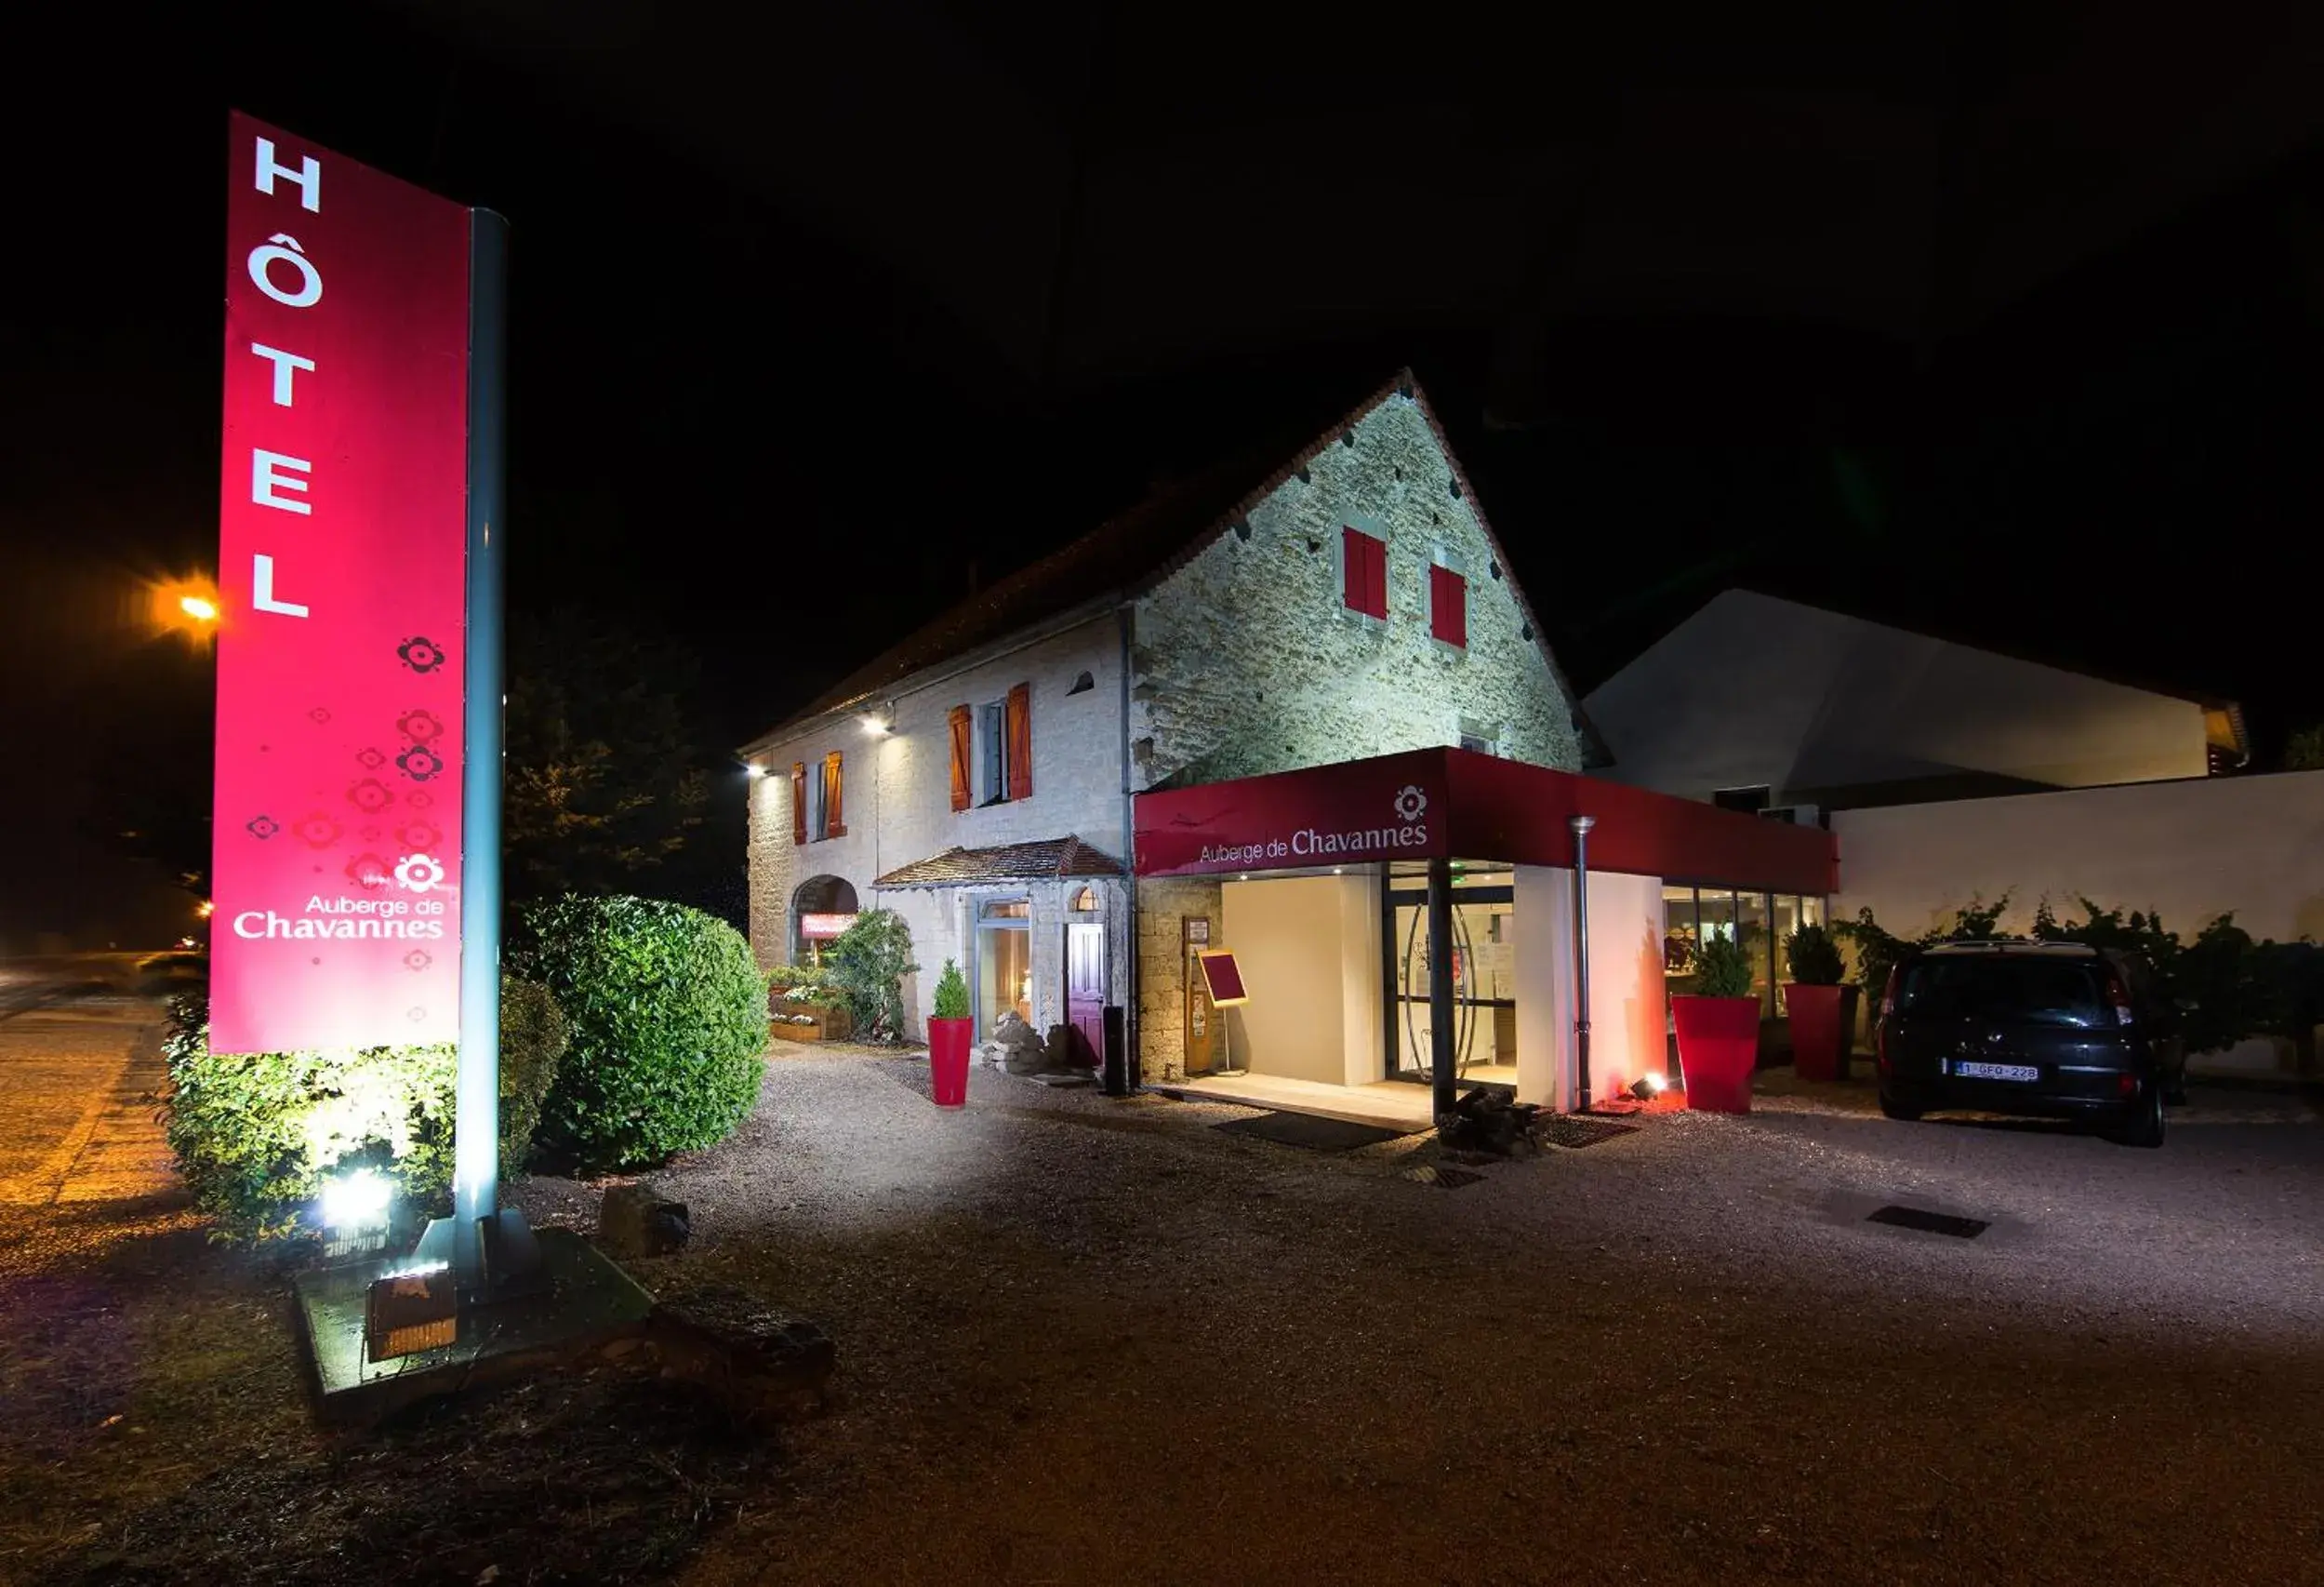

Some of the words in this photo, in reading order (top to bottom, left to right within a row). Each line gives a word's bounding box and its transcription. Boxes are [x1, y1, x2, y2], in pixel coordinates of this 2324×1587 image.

[247, 136, 323, 618] HÔTEL
[1201, 840, 1264, 863] Auberge
[1267, 839, 1287, 858] de
[1292, 825, 1428, 855] Chavannes
[306, 896, 408, 917] Auberge
[415, 898, 445, 915] de
[233, 911, 444, 939] Chavannes
